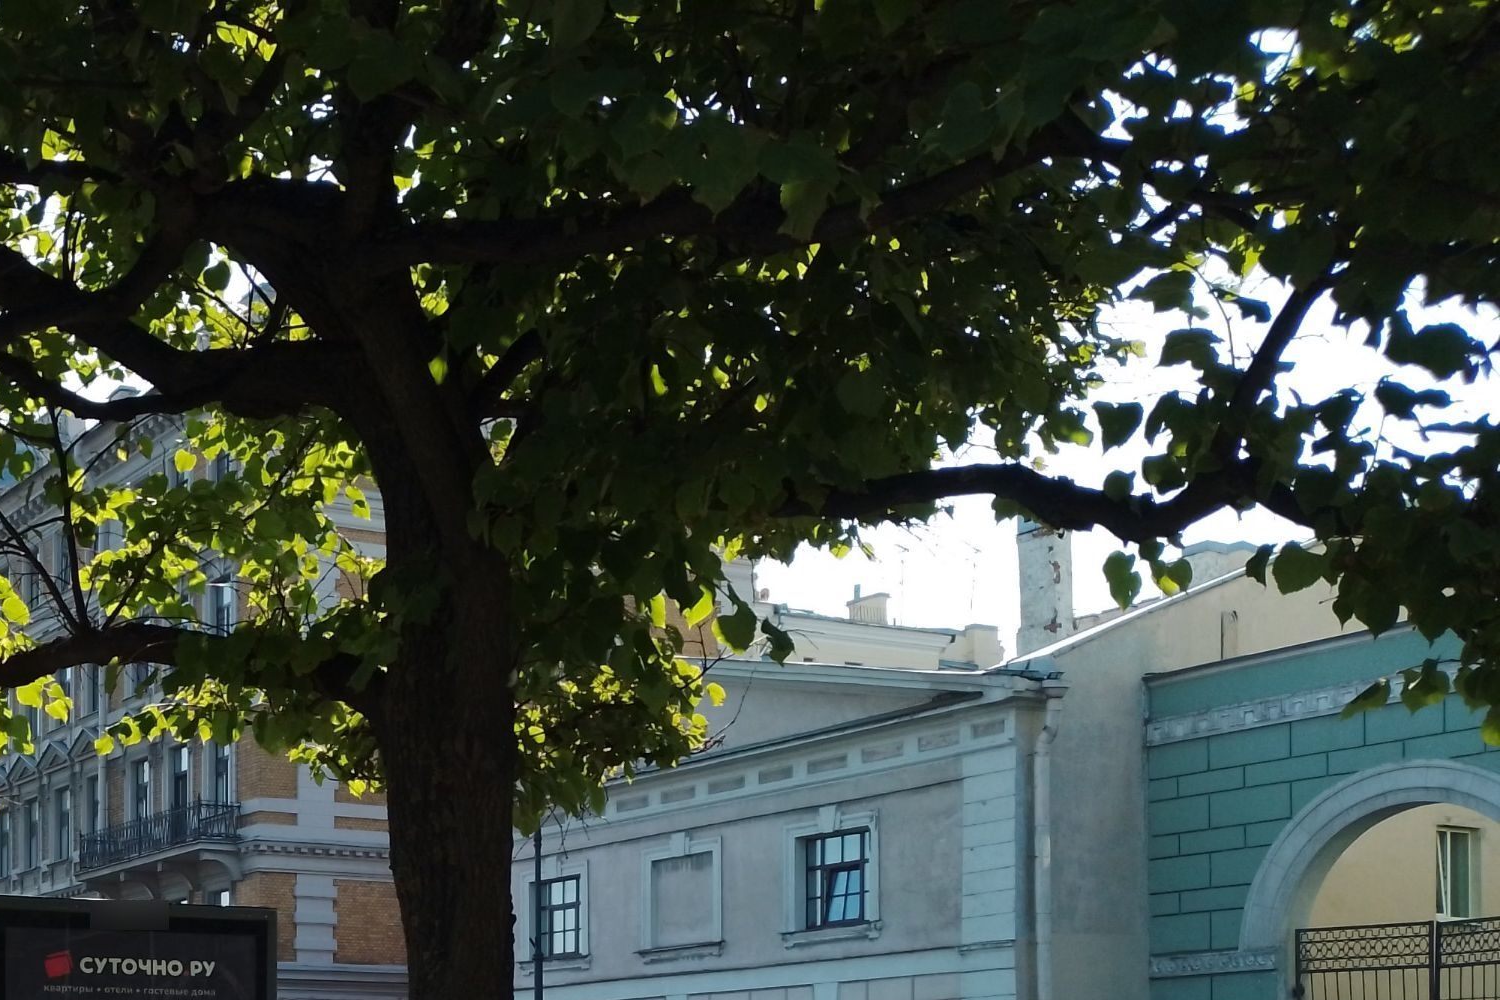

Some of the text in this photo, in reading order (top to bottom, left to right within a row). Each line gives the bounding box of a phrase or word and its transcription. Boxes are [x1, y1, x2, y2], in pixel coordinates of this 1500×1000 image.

[79, 956, 216, 977] СУТОЧНО.РУ
[43, 984, 216, 997] квартиры отели гостевые дома
